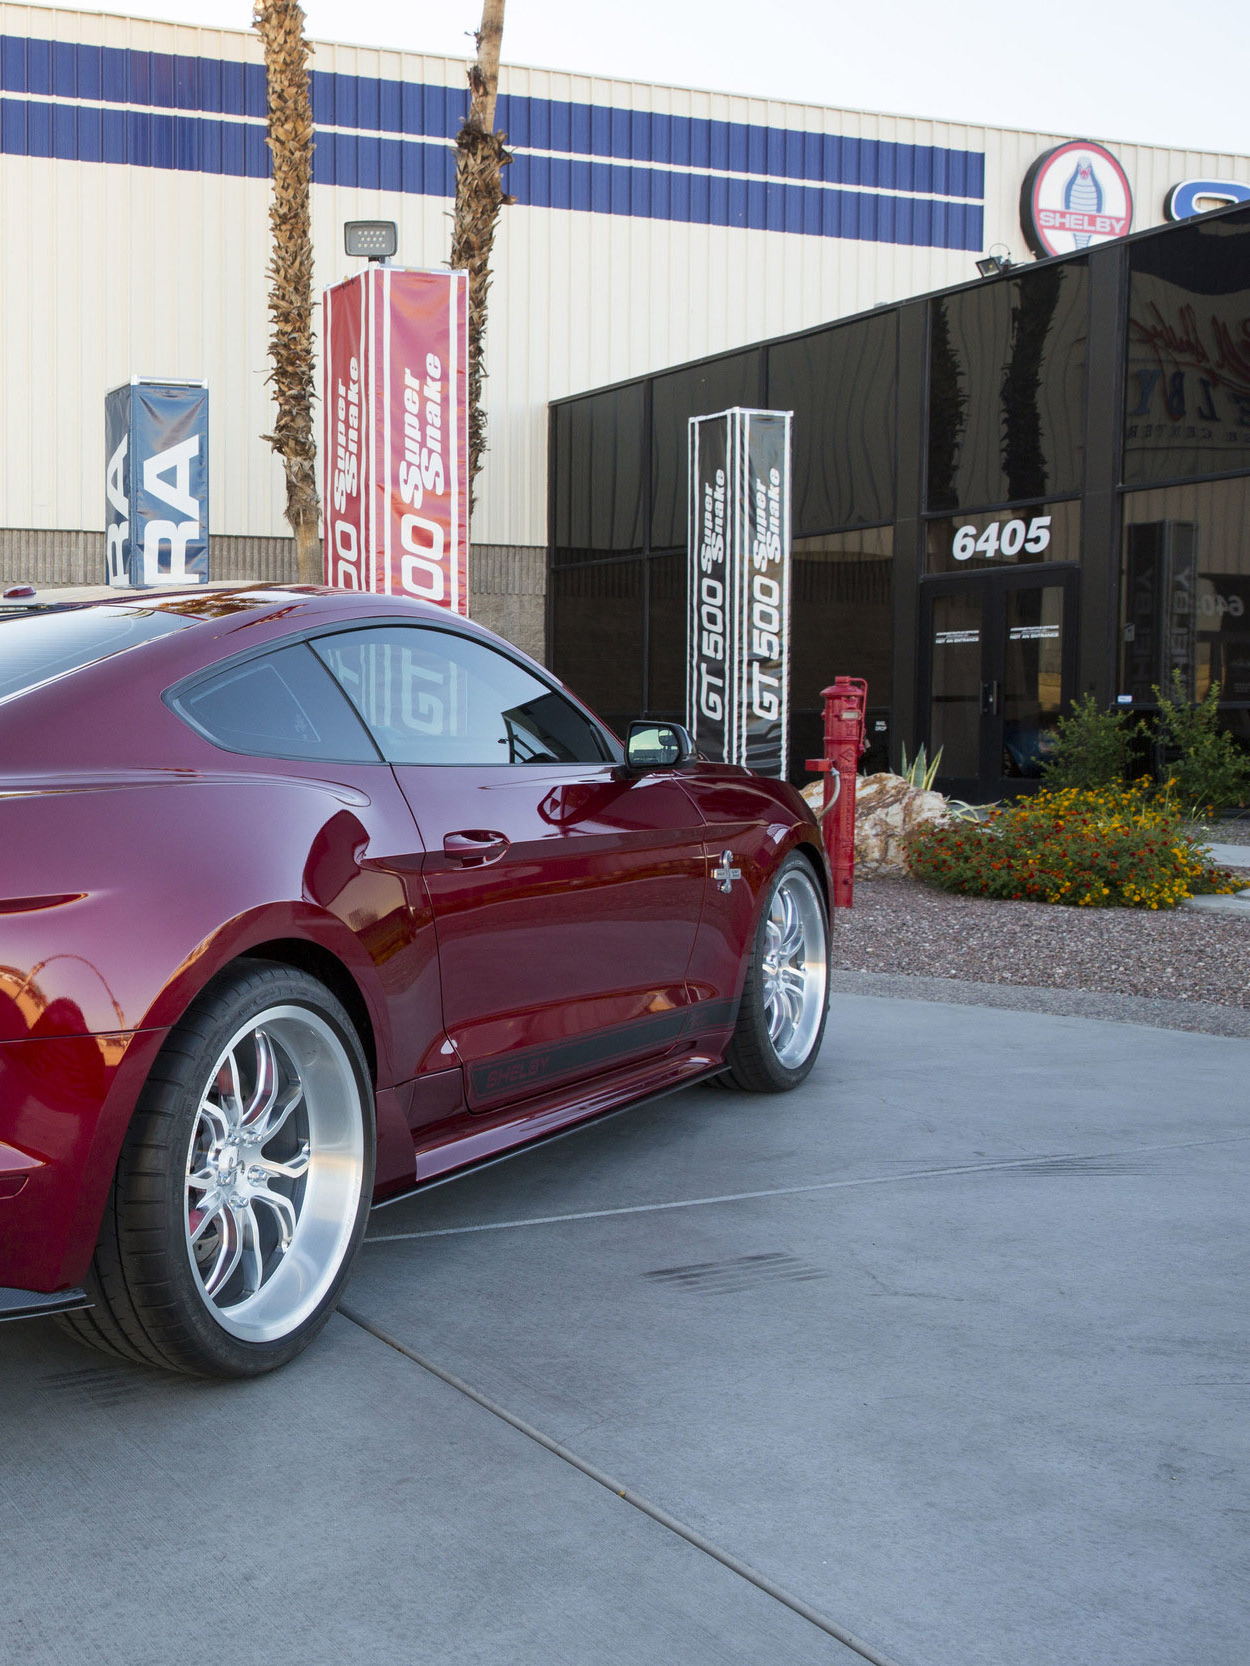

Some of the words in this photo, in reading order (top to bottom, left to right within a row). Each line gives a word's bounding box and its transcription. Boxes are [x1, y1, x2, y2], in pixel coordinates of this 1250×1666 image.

[1039, 210, 1127, 234] SHELBY
[334, 377, 347, 514] Super
[345, 356, 359, 498] Snake
[399, 367, 424, 510] Super
[420, 352, 445, 496] Snake
[106, 432, 129, 587] RA
[143, 433, 200, 585] RA
[335, 519, 359, 591] 00
[701, 482, 713, 574] Super
[711, 468, 726, 564] Snake
[753, 477, 767, 573] Super
[766, 467, 781, 564] Snake
[952, 515, 1052, 561] 6405
[400, 512, 445, 602] 00
[702, 577, 724, 661] 500
[753, 574, 781, 660] 500
[701, 663, 723, 721] GT
[752, 661, 779, 721] GT
[486, 1057, 549, 1088] SHELBY
